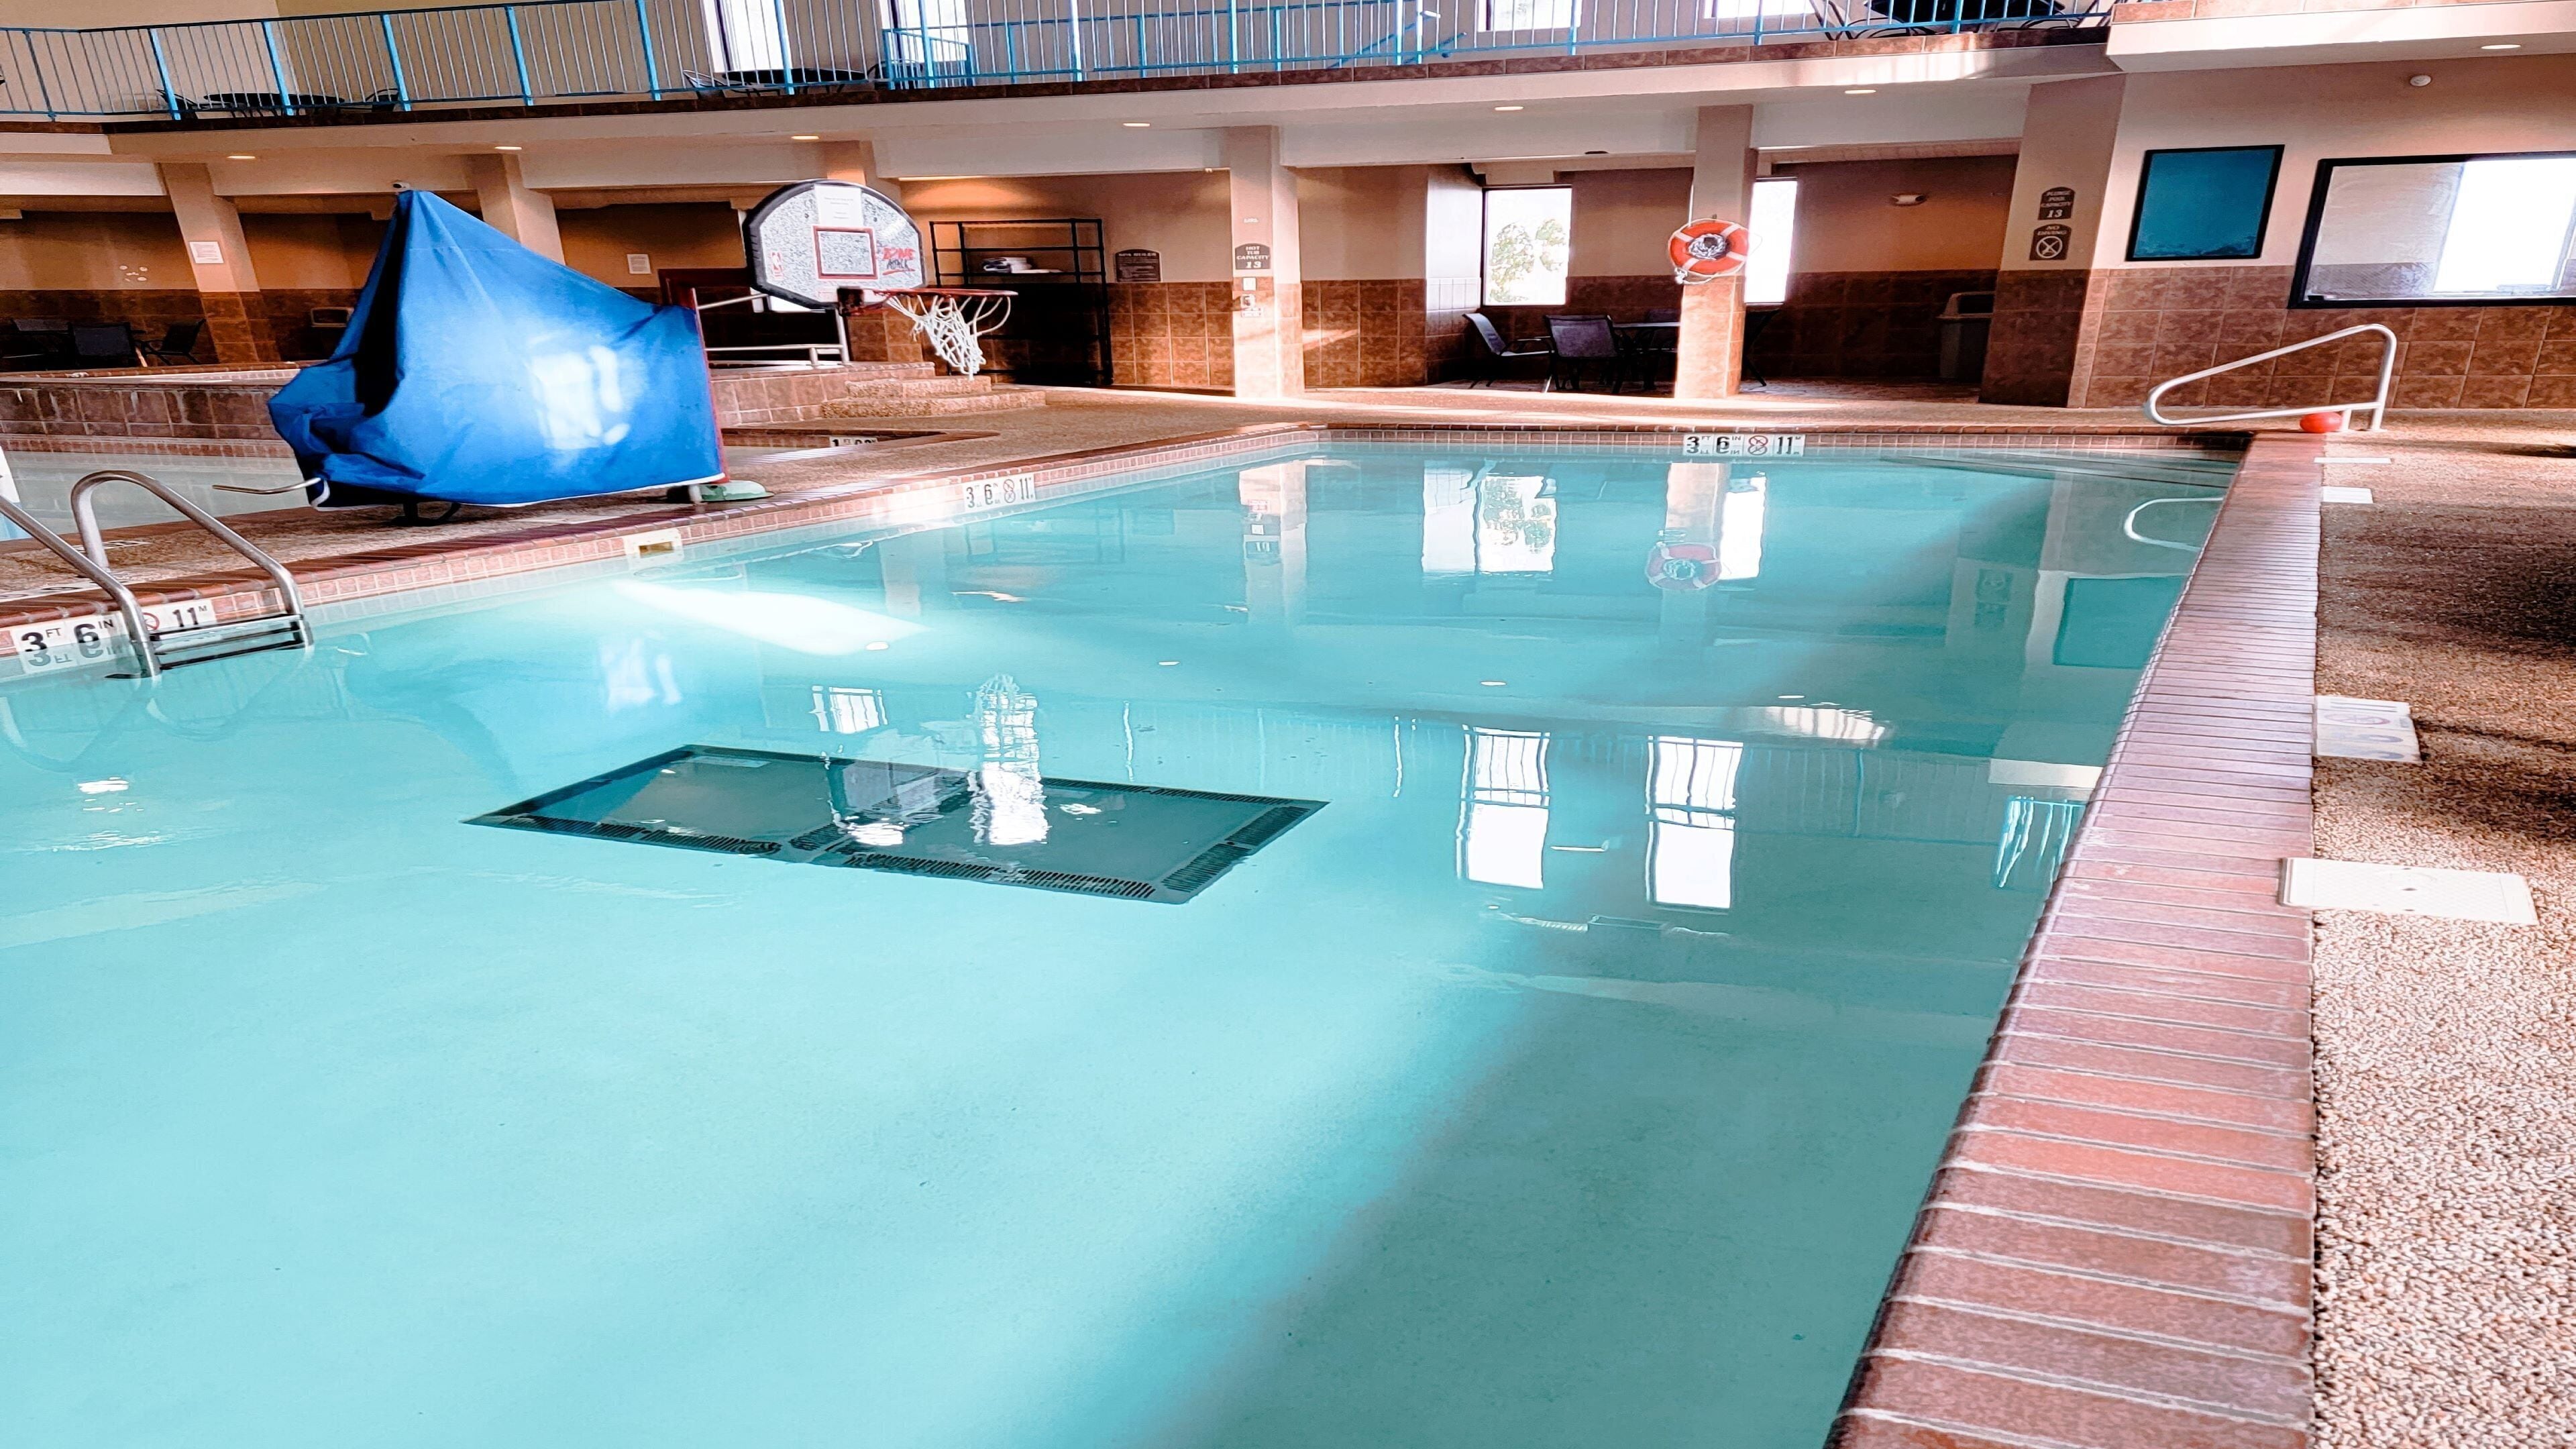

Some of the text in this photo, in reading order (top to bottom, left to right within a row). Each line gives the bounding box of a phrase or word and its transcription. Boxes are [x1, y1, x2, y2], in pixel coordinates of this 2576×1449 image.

[2047, 209, 2063, 218] 13
[21, 631, 48, 652] 3
[46, 627, 62, 638] FT
[74, 623, 100, 643] 6
[98, 619, 114, 630] IN
